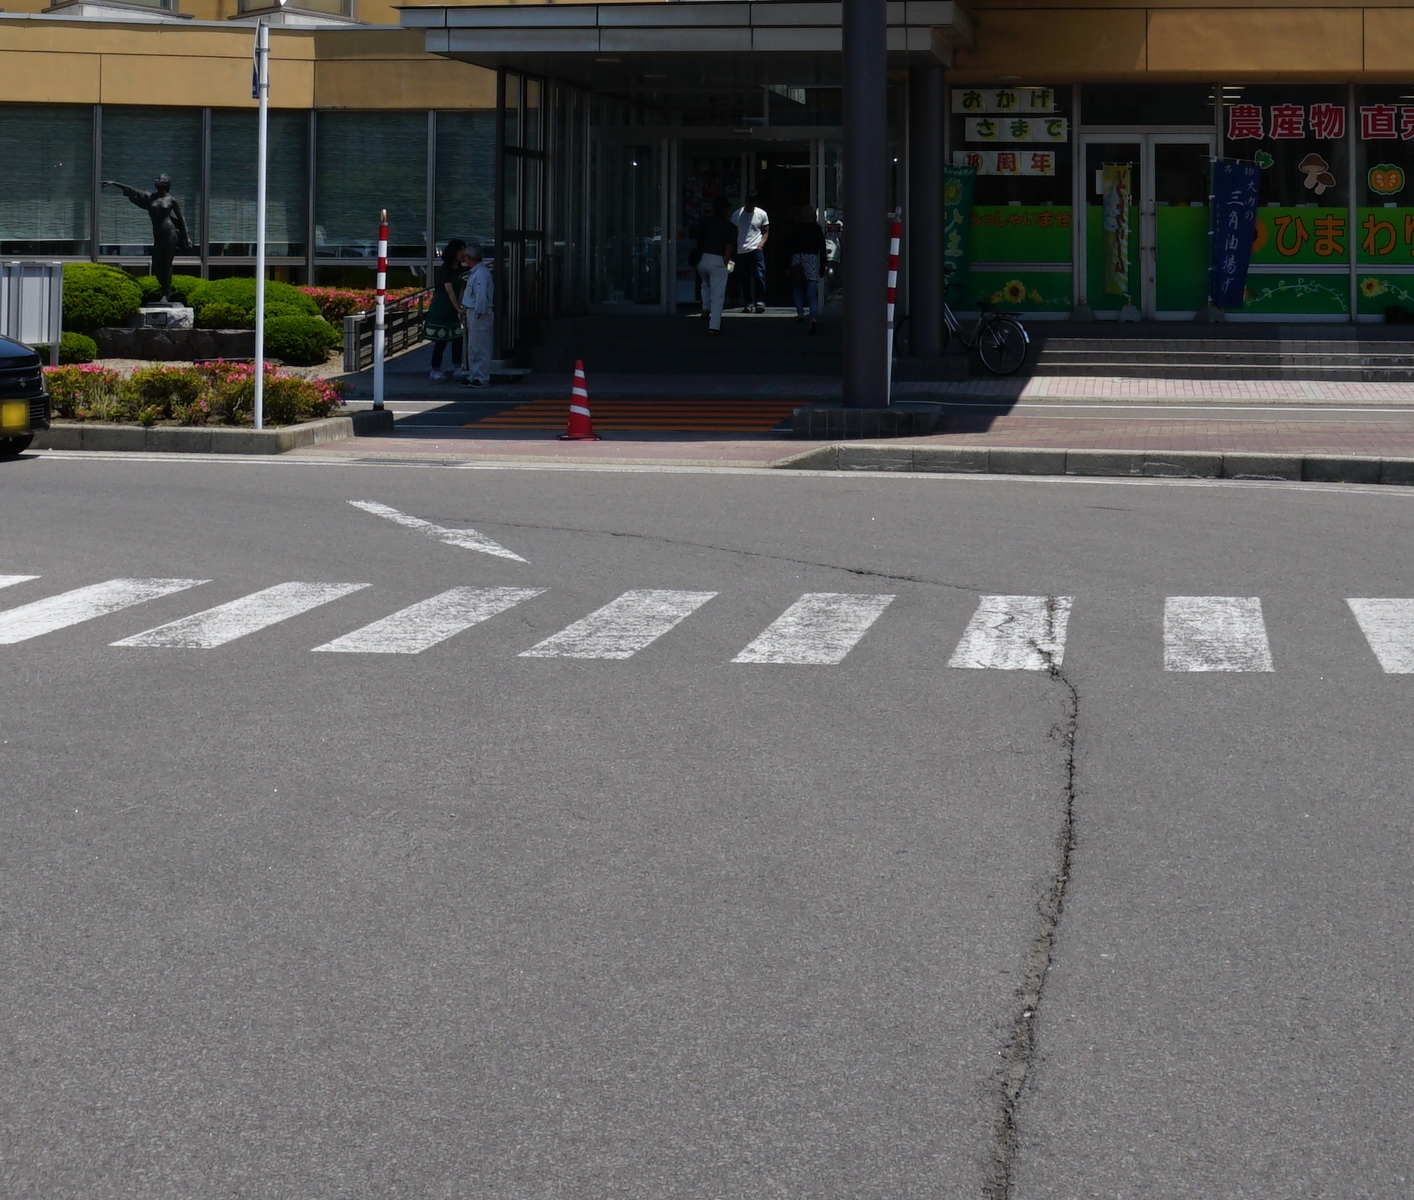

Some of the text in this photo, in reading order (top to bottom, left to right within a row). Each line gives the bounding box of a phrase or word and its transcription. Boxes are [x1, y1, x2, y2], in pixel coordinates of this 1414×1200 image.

[962, 90, 1051, 110] おかげ
[976, 118, 1063, 138] さまで
[970, 210, 1072, 227] らっしゃいませ
